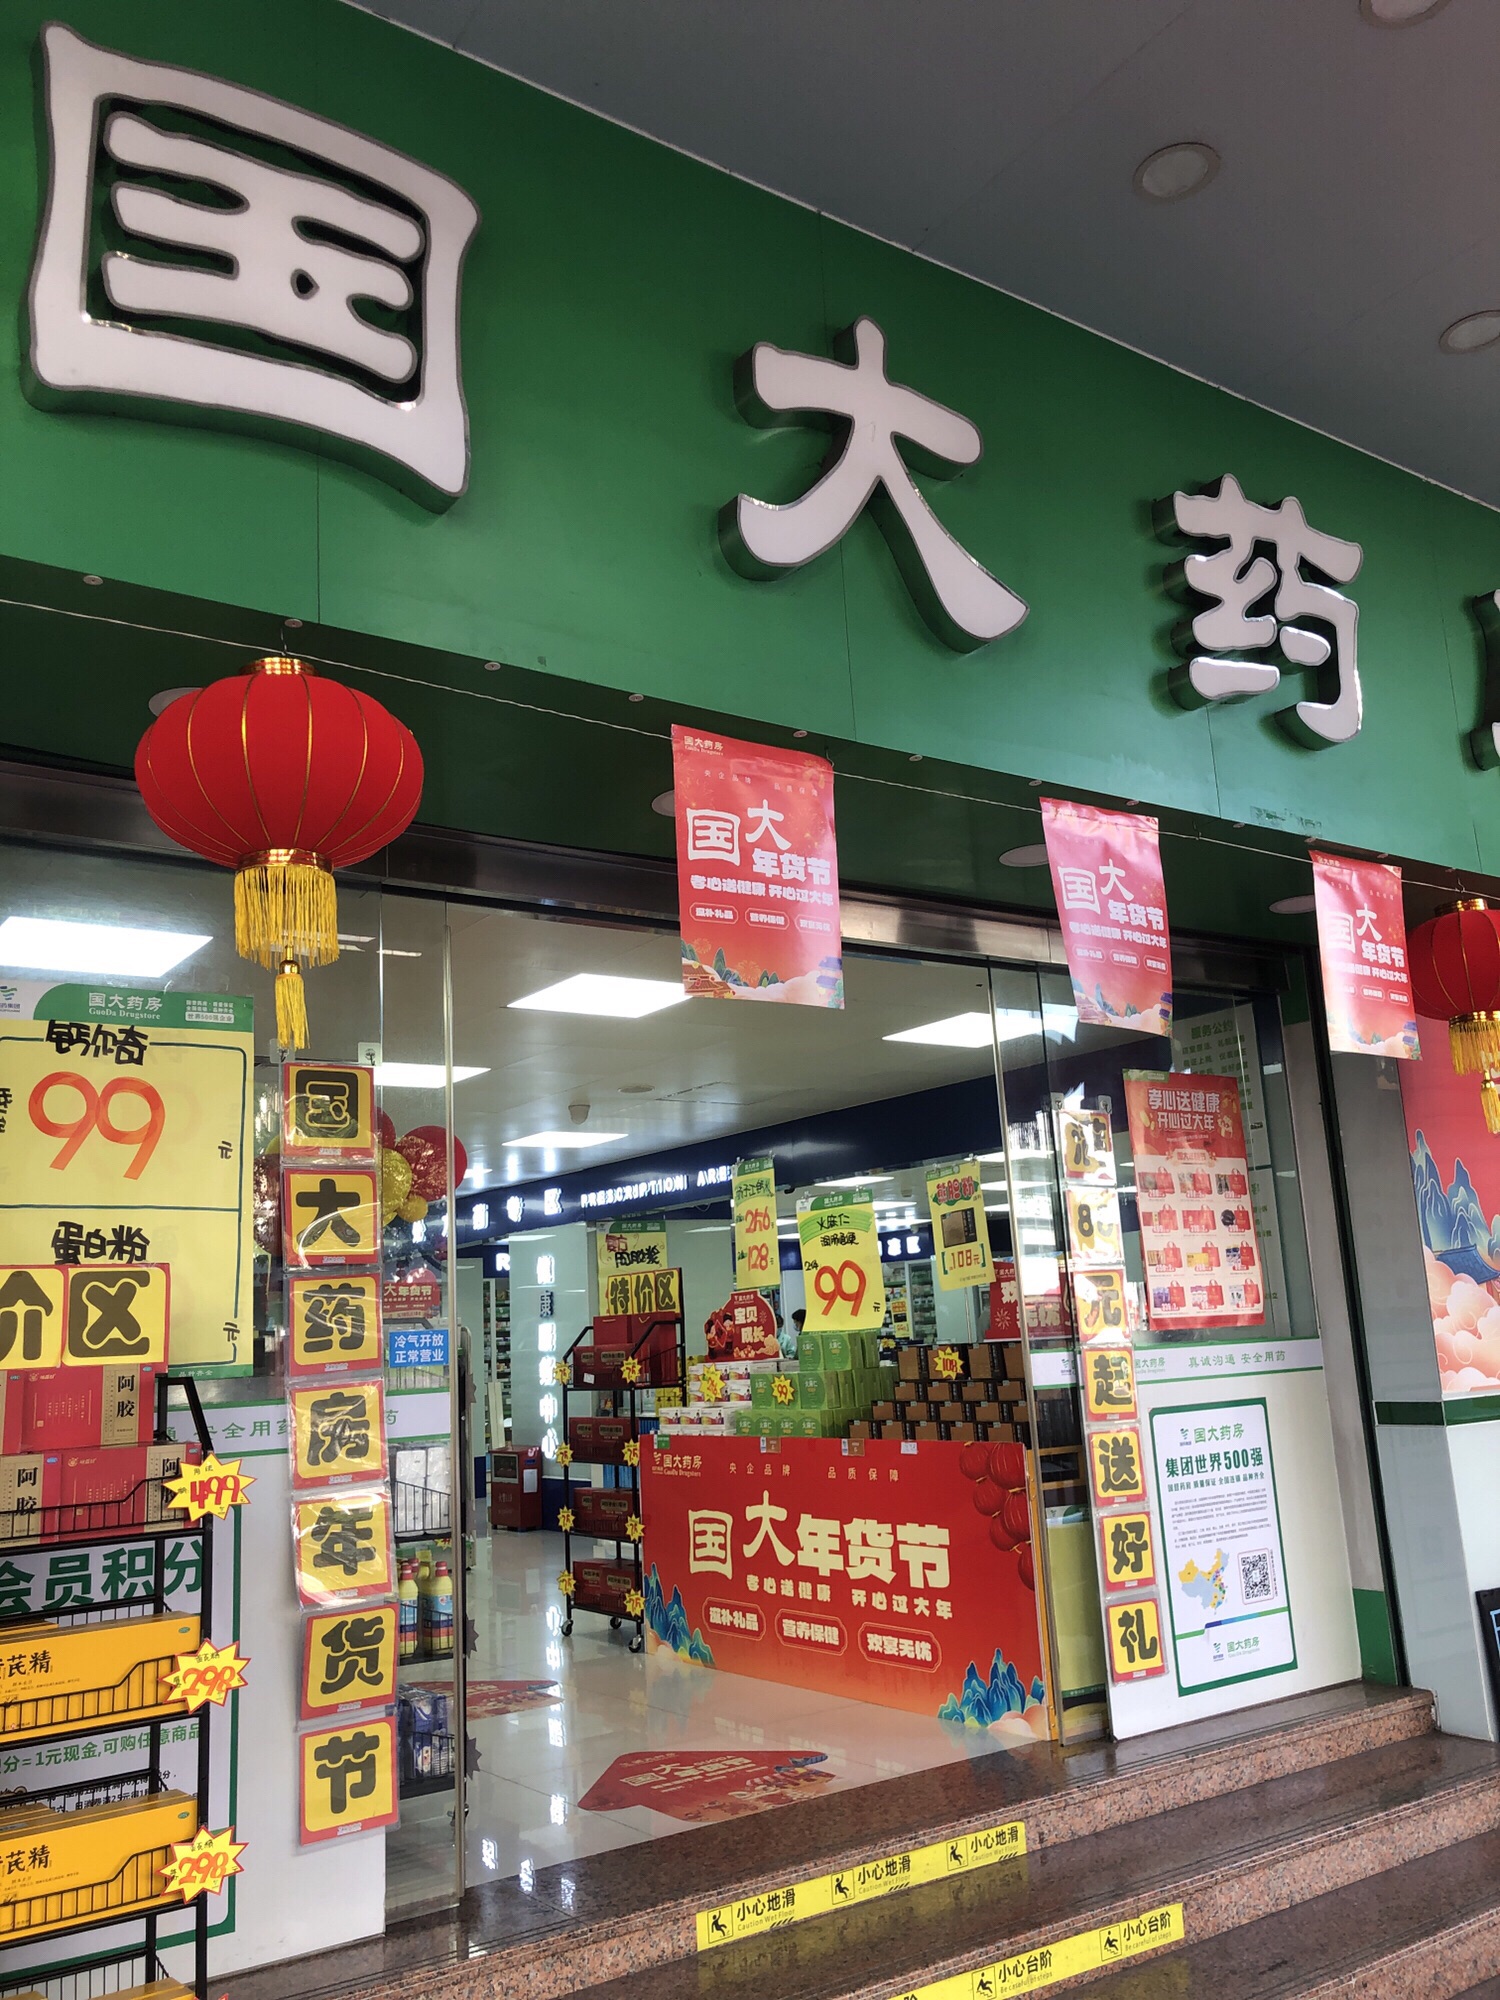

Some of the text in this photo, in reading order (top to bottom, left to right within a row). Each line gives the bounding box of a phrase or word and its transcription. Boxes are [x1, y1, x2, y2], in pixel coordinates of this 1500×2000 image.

[25, 22, 1500, 770] 国大药
[686, 799, 792, 866] 国大
[752, 848, 831, 886] 年货节
[1058, 858, 1134, 915] 国大
[1108, 899, 1164, 931] 年货节
[1361, 940, 1405, 968] 年货节
[89, 992, 163, 1012] 国大药房
[89, 1007, 161, 1021] GuoDa Drugstore
[46, 1019, 149, 1066] 钙尔奇
[1148, 1087, 1221, 1113] 孝心送健康
[28, 1070, 166, 1180] 99
[1157, 1112, 1215, 1131] 开心过大年
[697, 1163, 734, 1189] ARE
[817, 1212, 850, 1231] 火麻仁
[52, 1220, 150, 1264] 蛋白粉
[748, 1243, 769, 1272] 128
[610, 1271, 677, 1315] 特价区
[814, 1260, 867, 1317] 99
[734, 1306, 758, 1325] 宝贝
[394, 1334, 444, 1348] 冷气开放
[394, 1348, 444, 1363] 正常营业
[1188, 1349, 1286, 1368] 真诚沟通 安全用药
[116, 1374, 135, 1418] 阿胶
[777, 1383, 789, 1397] 99
[1194, 1423, 1244, 1444] 国大药房
[663, 1453, 702, 1469] 国大药房
[729, 1462, 791, 1477] 央企品牌
[828, 1466, 899, 1483] 品质保障
[1165, 1447, 1263, 1478] 集团世界500强
[15, 1467, 38, 1516] 阿胶
[190, 1474, 241, 1509] 499
[687, 1490, 951, 1590] 国大年货节
[746, 1574, 953, 1620] 孝心送健康 开心过大年
[709, 1606, 759, 1632] 滋补礼品
[782, 1618, 840, 1646] 营养保健
[0, 1650, 51, 1680] 芪精
[181, 1665, 236, 1697] 298
[970, 1826, 1019, 1854] 小心地滑
[0, 1844, 50, 1875] 芪精
[179, 1851, 229, 1886] 298
[857, 1855, 911, 1886] 小心地滑
[736, 1887, 796, 1922] 小心地滑
[737, 1919, 763, 1932] Caution
[1123, 1910, 1171, 1942] 小心台阶
[998, 1949, 1052, 1984] 小心台阶
